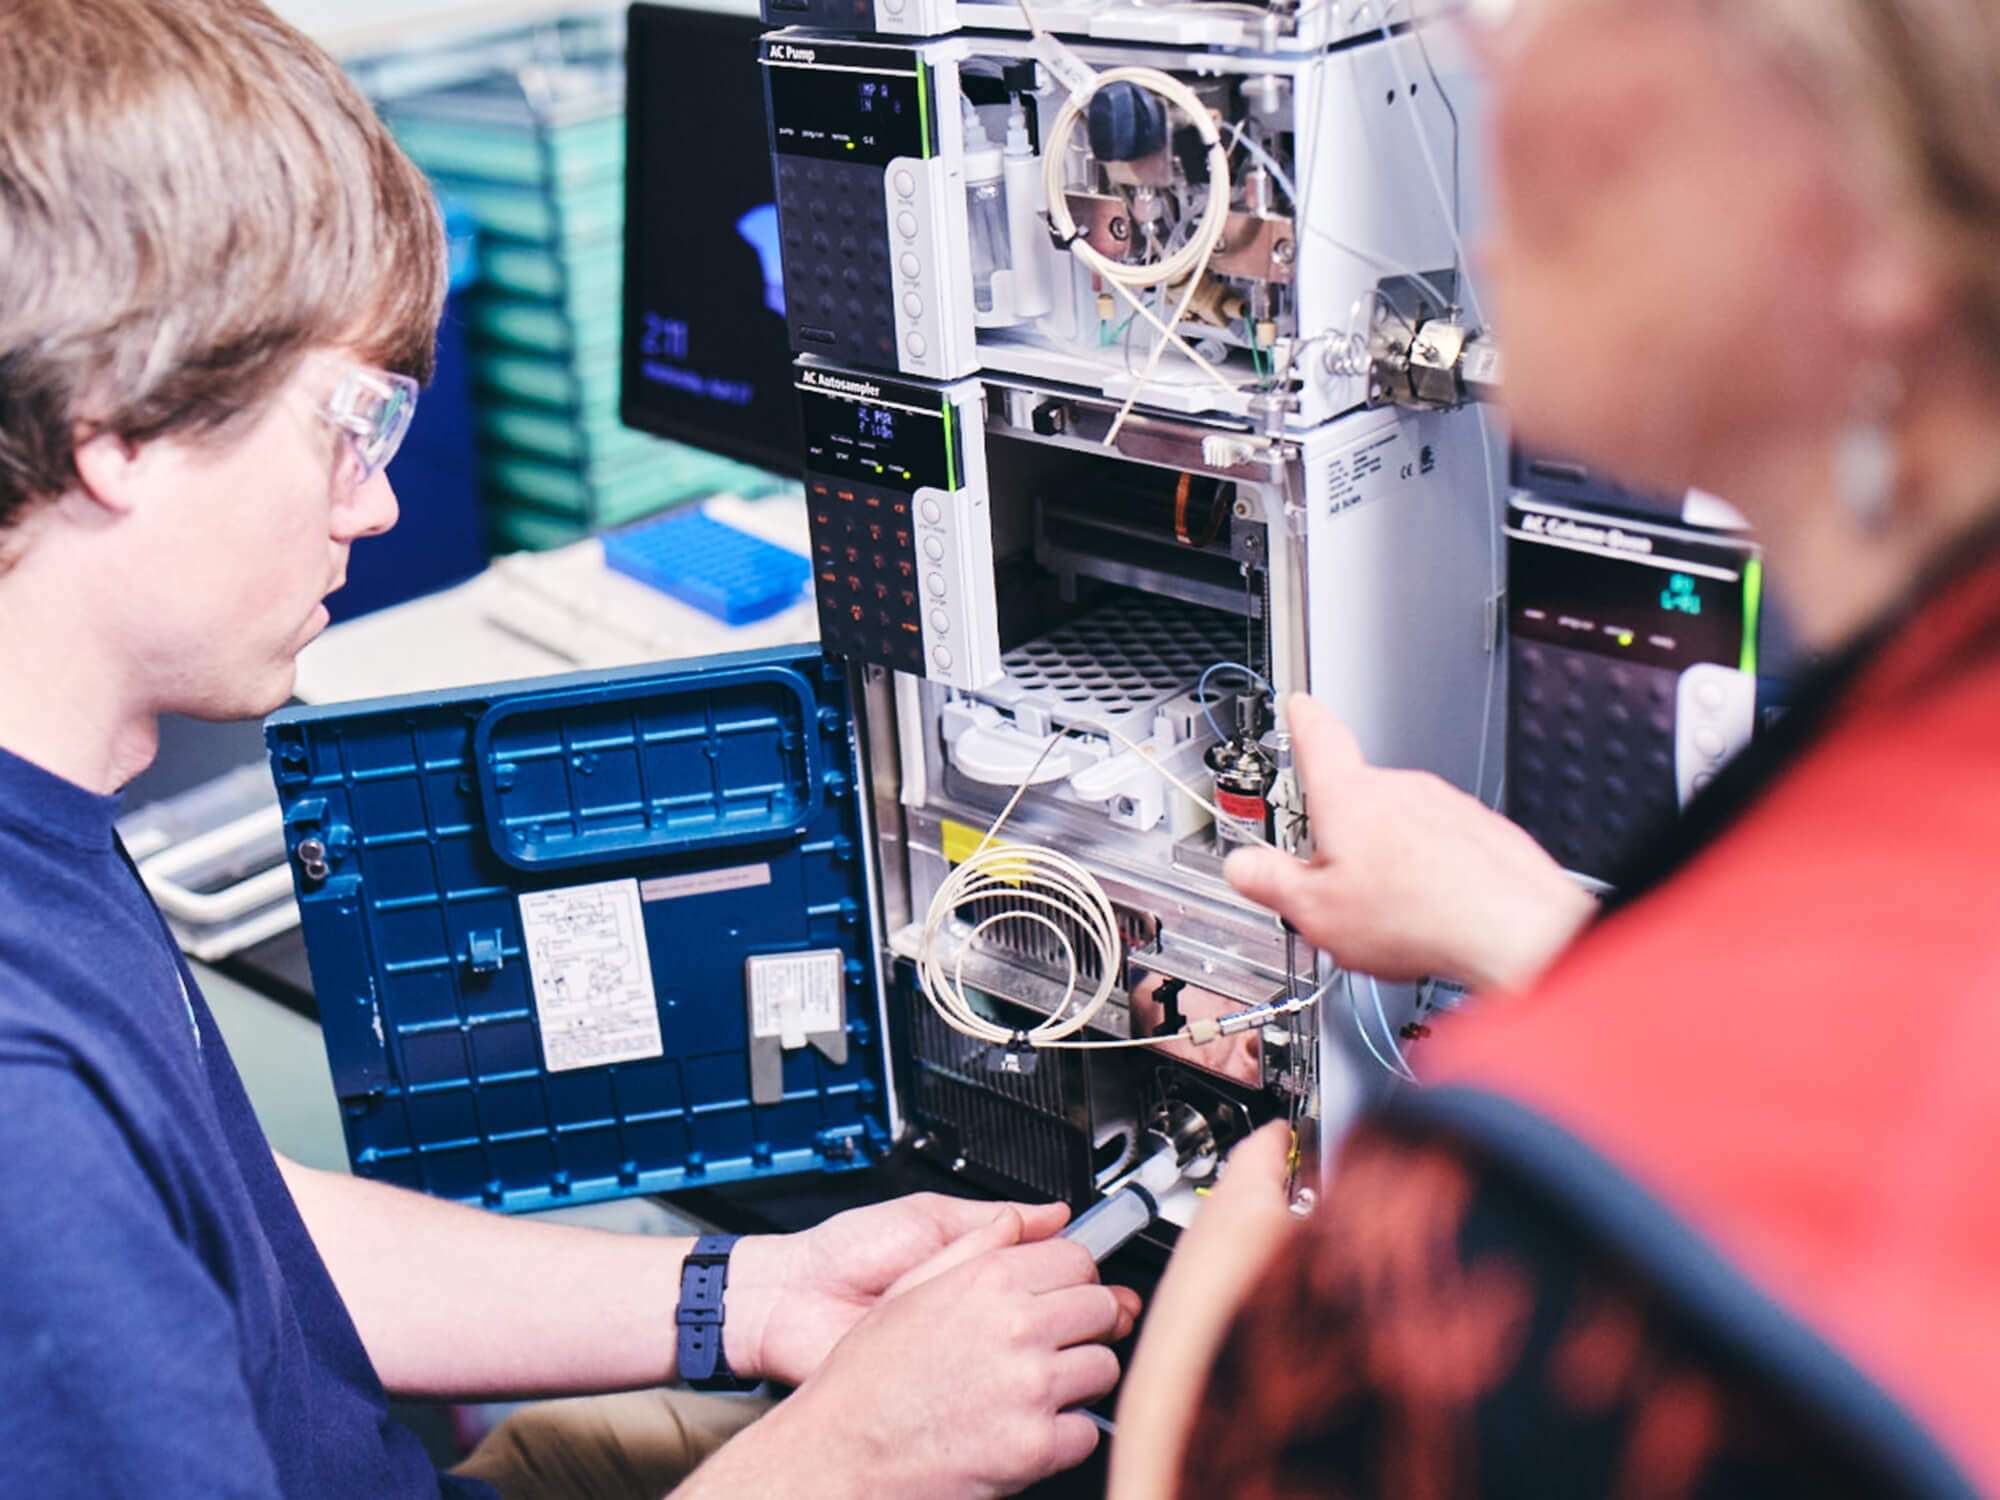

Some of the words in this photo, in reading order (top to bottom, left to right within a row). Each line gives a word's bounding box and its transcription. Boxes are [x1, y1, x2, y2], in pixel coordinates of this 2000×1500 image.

[769, 45, 784, 59] AC
[785, 46, 816, 64] Pump
[802, 370, 817, 384] AC
[818, 373, 881, 398] Autosampler
